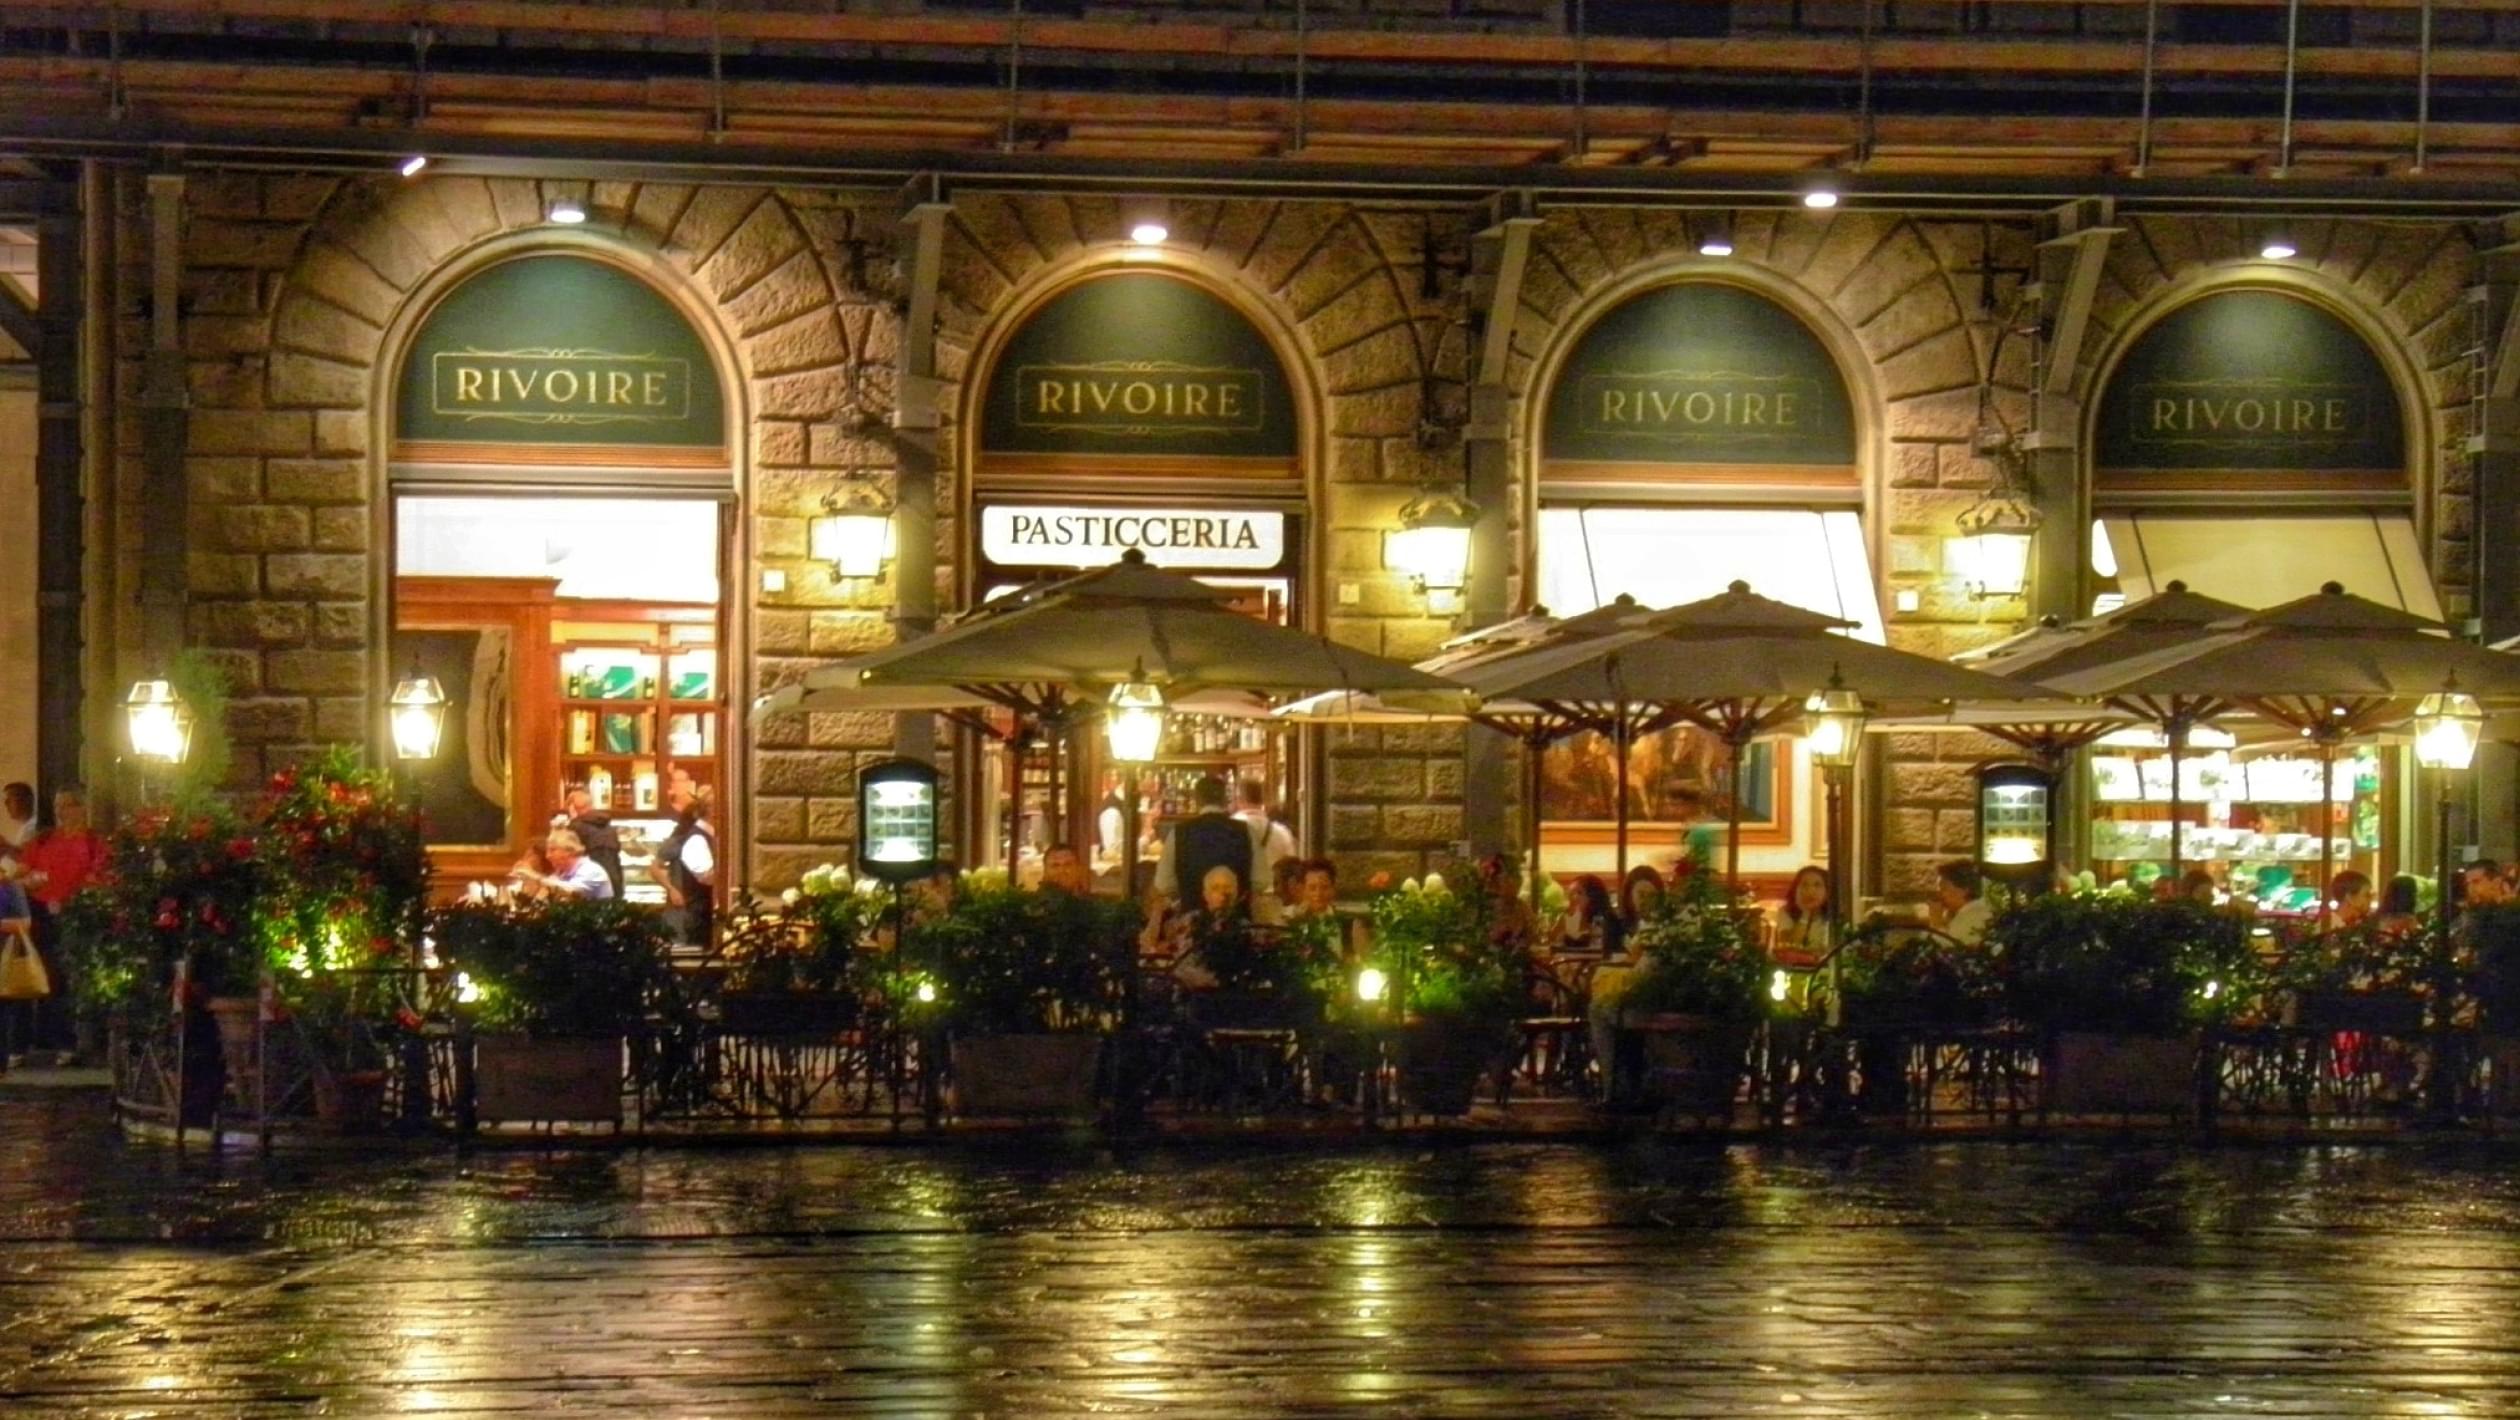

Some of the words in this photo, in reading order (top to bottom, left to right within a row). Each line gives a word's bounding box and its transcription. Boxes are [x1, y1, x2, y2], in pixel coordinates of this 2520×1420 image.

[456, 367, 668, 406] RIVOIRE
[1038, 379, 1242, 418] RIVOIRE
[1601, 389, 1799, 426] RIVOIRE
[2153, 398, 2347, 431] RIVOIRE
[1010, 514, 1260, 549] PASTICCERIA
